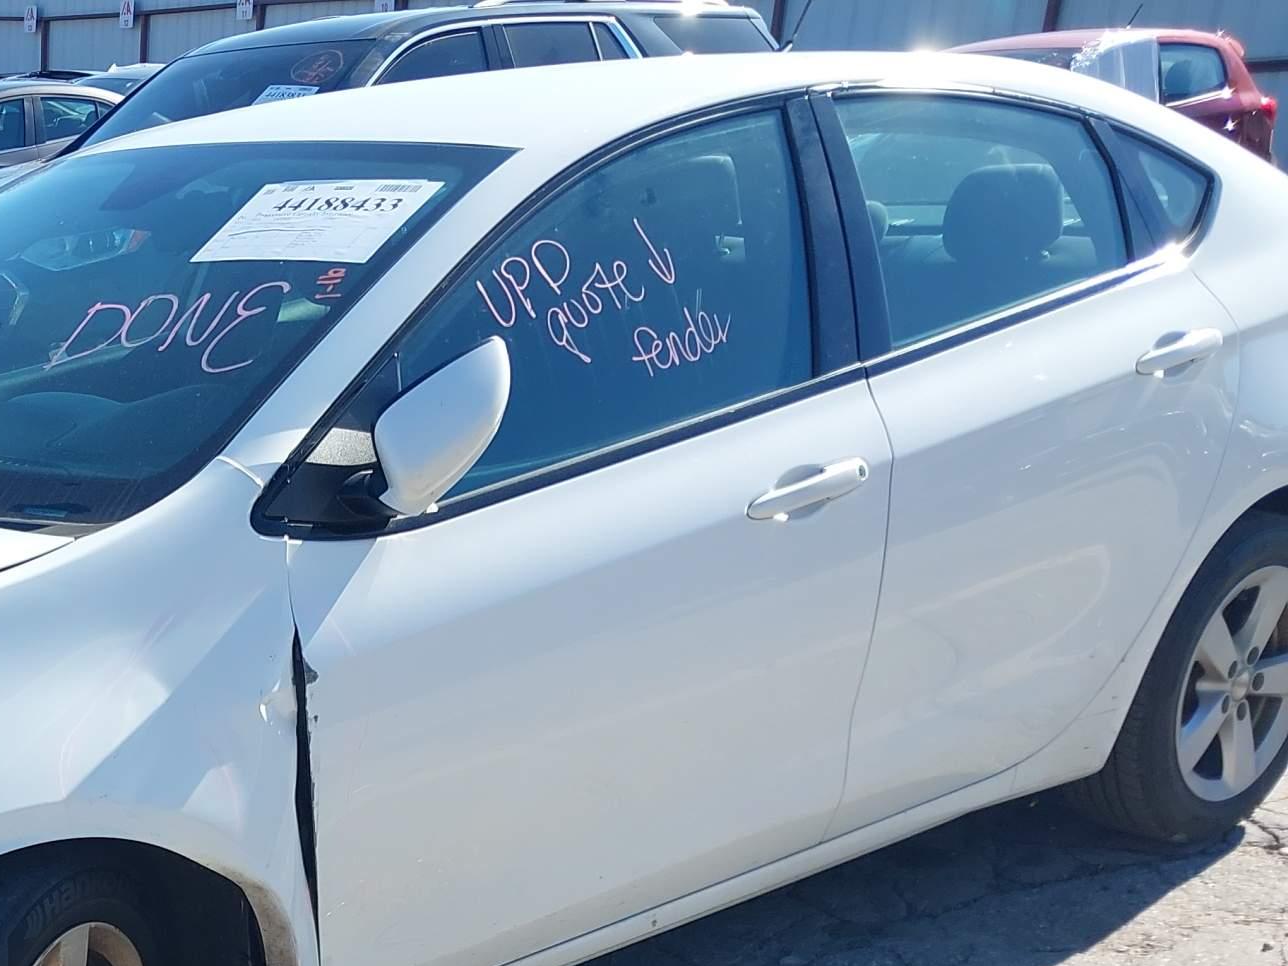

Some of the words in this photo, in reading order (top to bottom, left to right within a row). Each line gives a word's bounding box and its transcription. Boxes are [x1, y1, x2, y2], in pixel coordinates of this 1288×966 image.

[273, 196, 404, 213] 44188433
[43, 280, 291, 373] DONE
[632, 305, 731, 377] fender
